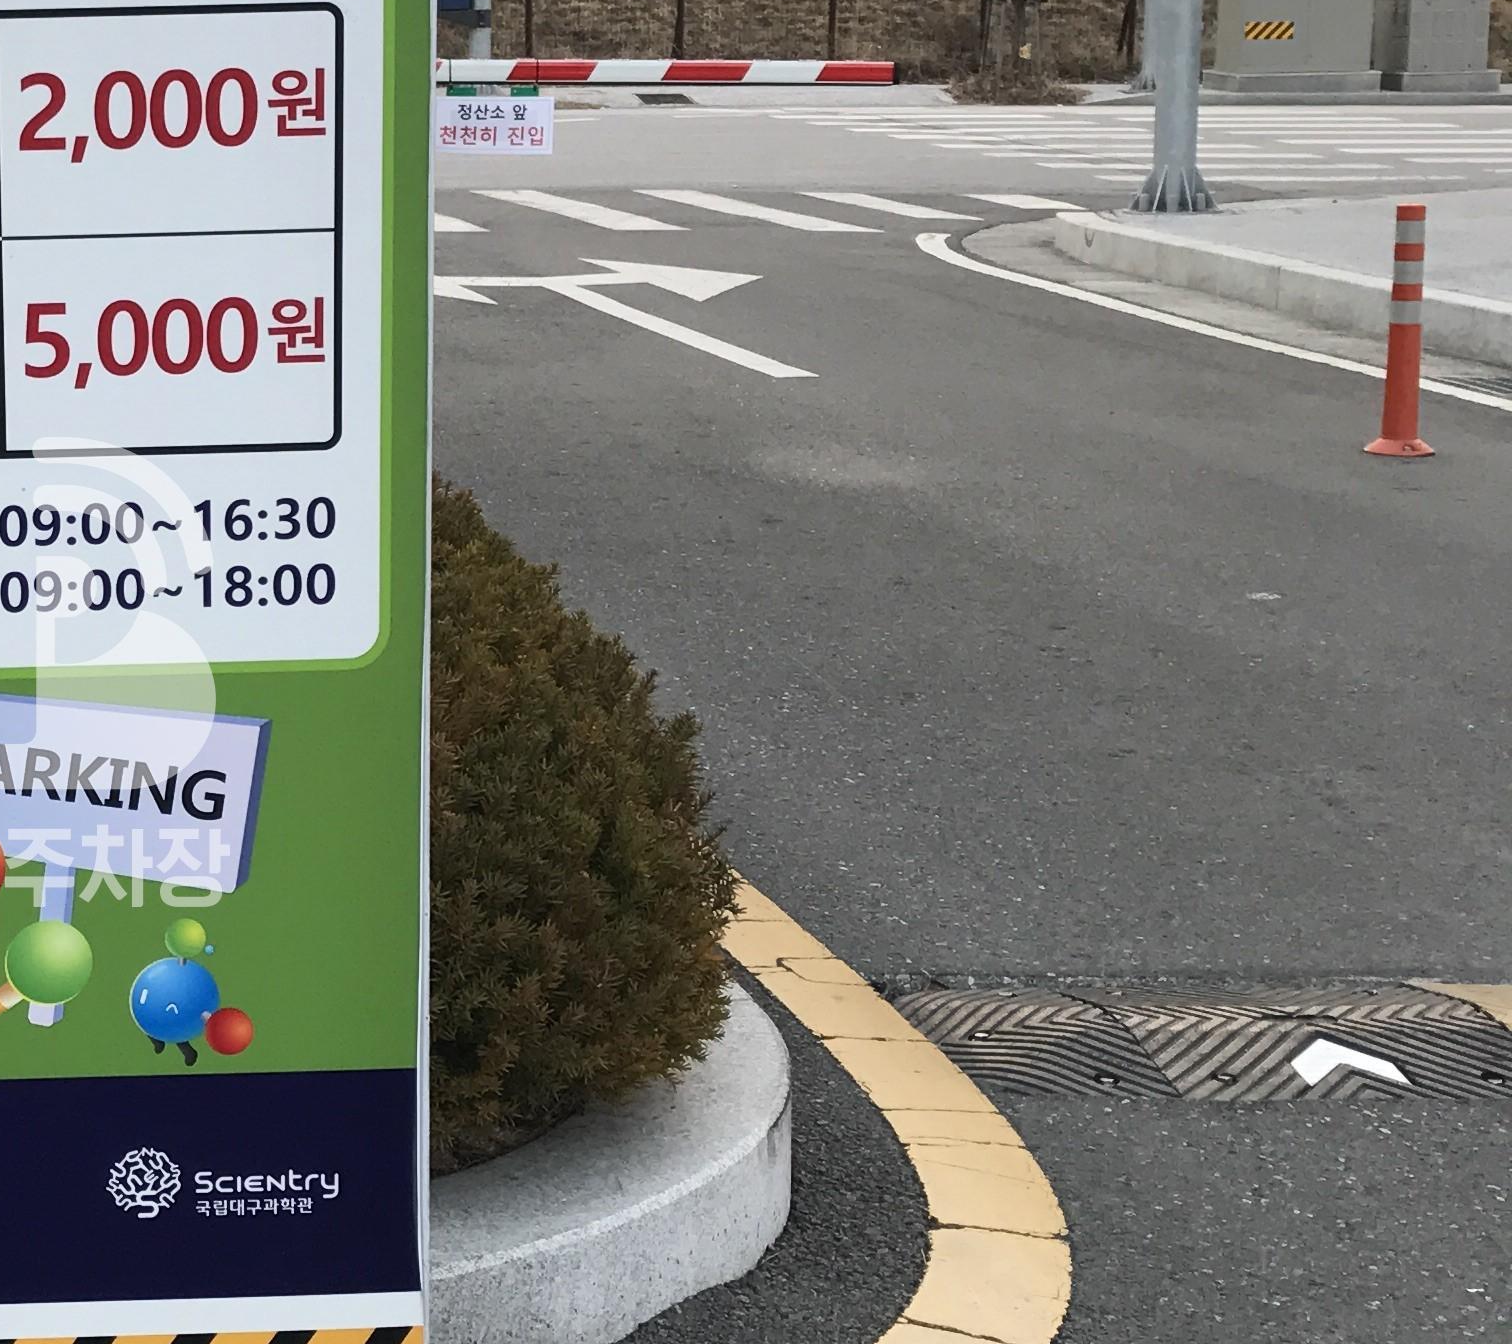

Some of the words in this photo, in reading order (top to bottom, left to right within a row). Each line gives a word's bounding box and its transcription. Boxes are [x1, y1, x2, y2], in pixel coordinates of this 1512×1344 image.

[19, 67, 328, 164] 2,000원
[457, 104, 506, 121] 정산소
[512, 104, 528, 121] 앞
[439, 125, 498, 146] 천천히
[508, 126, 544, 146] 진입
[24, 296, 327, 390] 5,000원
[195, 1197, 314, 1217] 국립대구과학관
